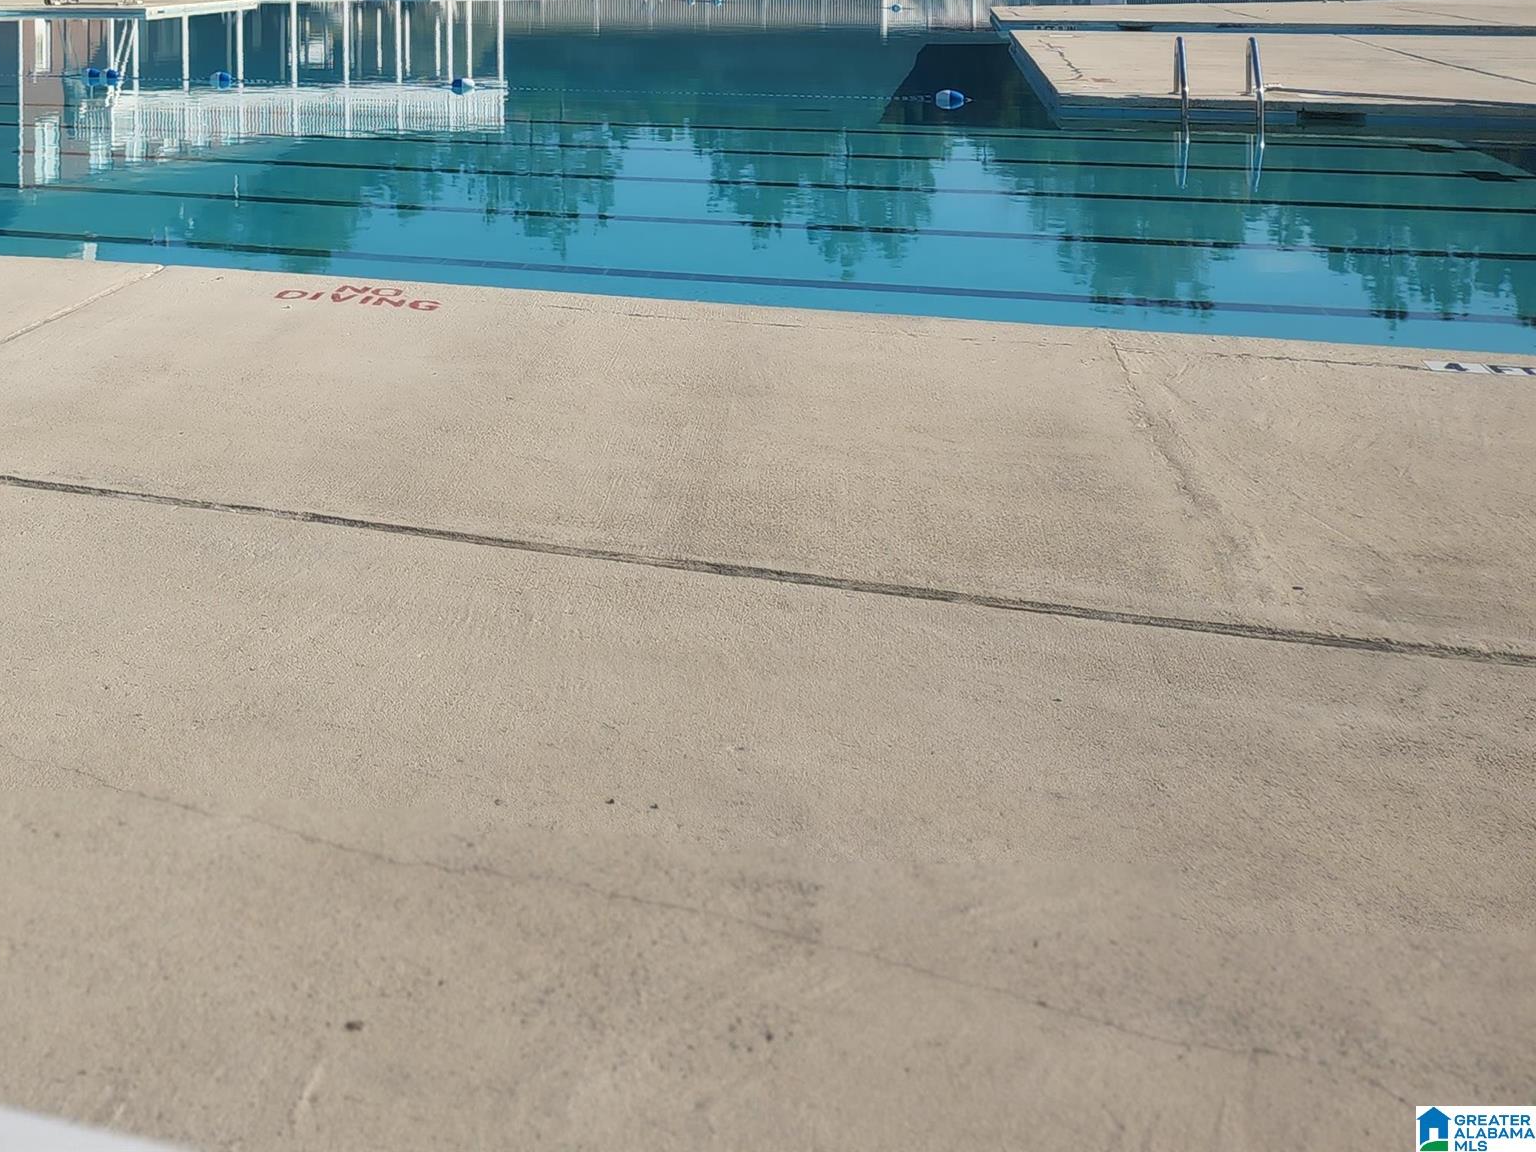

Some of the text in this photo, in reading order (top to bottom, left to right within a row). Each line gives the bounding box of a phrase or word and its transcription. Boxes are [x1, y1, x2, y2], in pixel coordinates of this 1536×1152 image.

[335, 285, 404, 297] NO
[274, 289, 442, 311] DIVING
[1444, 362, 1469, 372] 4
